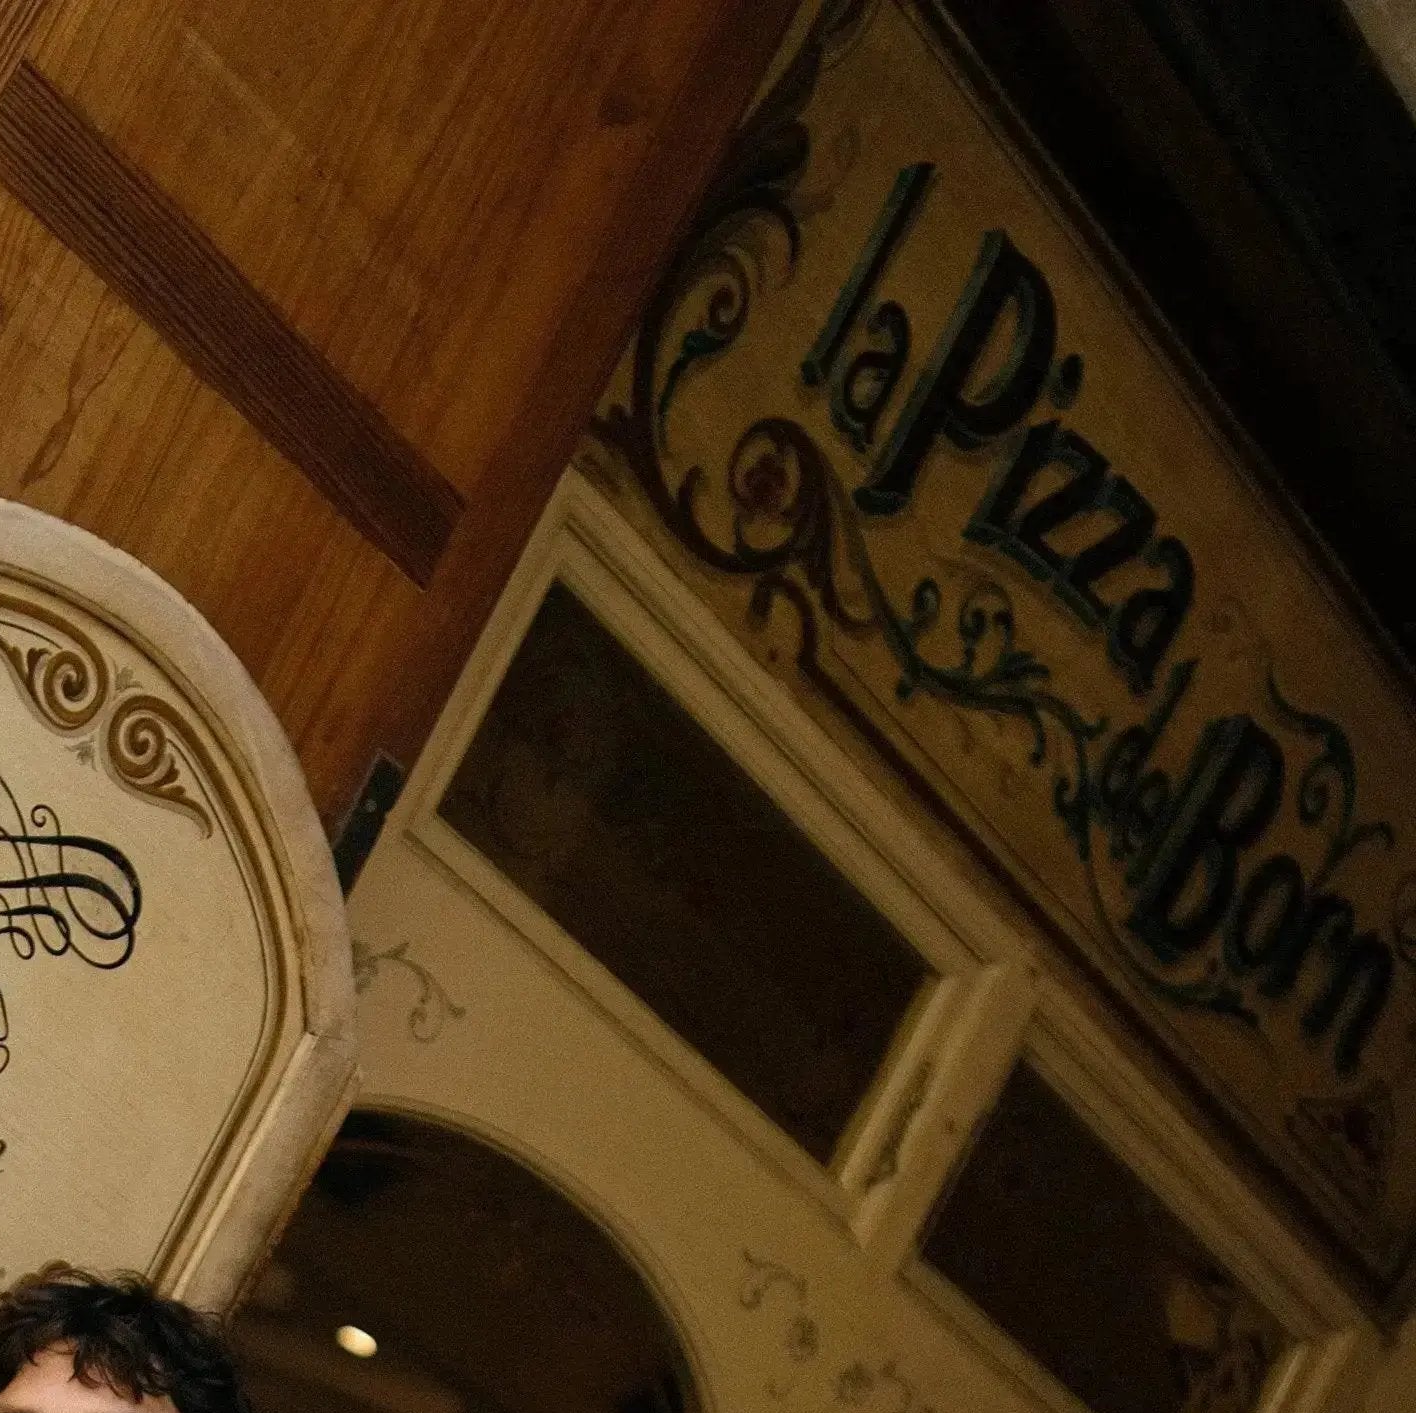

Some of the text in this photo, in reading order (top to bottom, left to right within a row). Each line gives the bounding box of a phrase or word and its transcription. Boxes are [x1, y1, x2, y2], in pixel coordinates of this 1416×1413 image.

[800, 160, 937, 450] la
[852, 228, 1196, 698] Pizza
[1128, 712, 1394, 1076] Born
